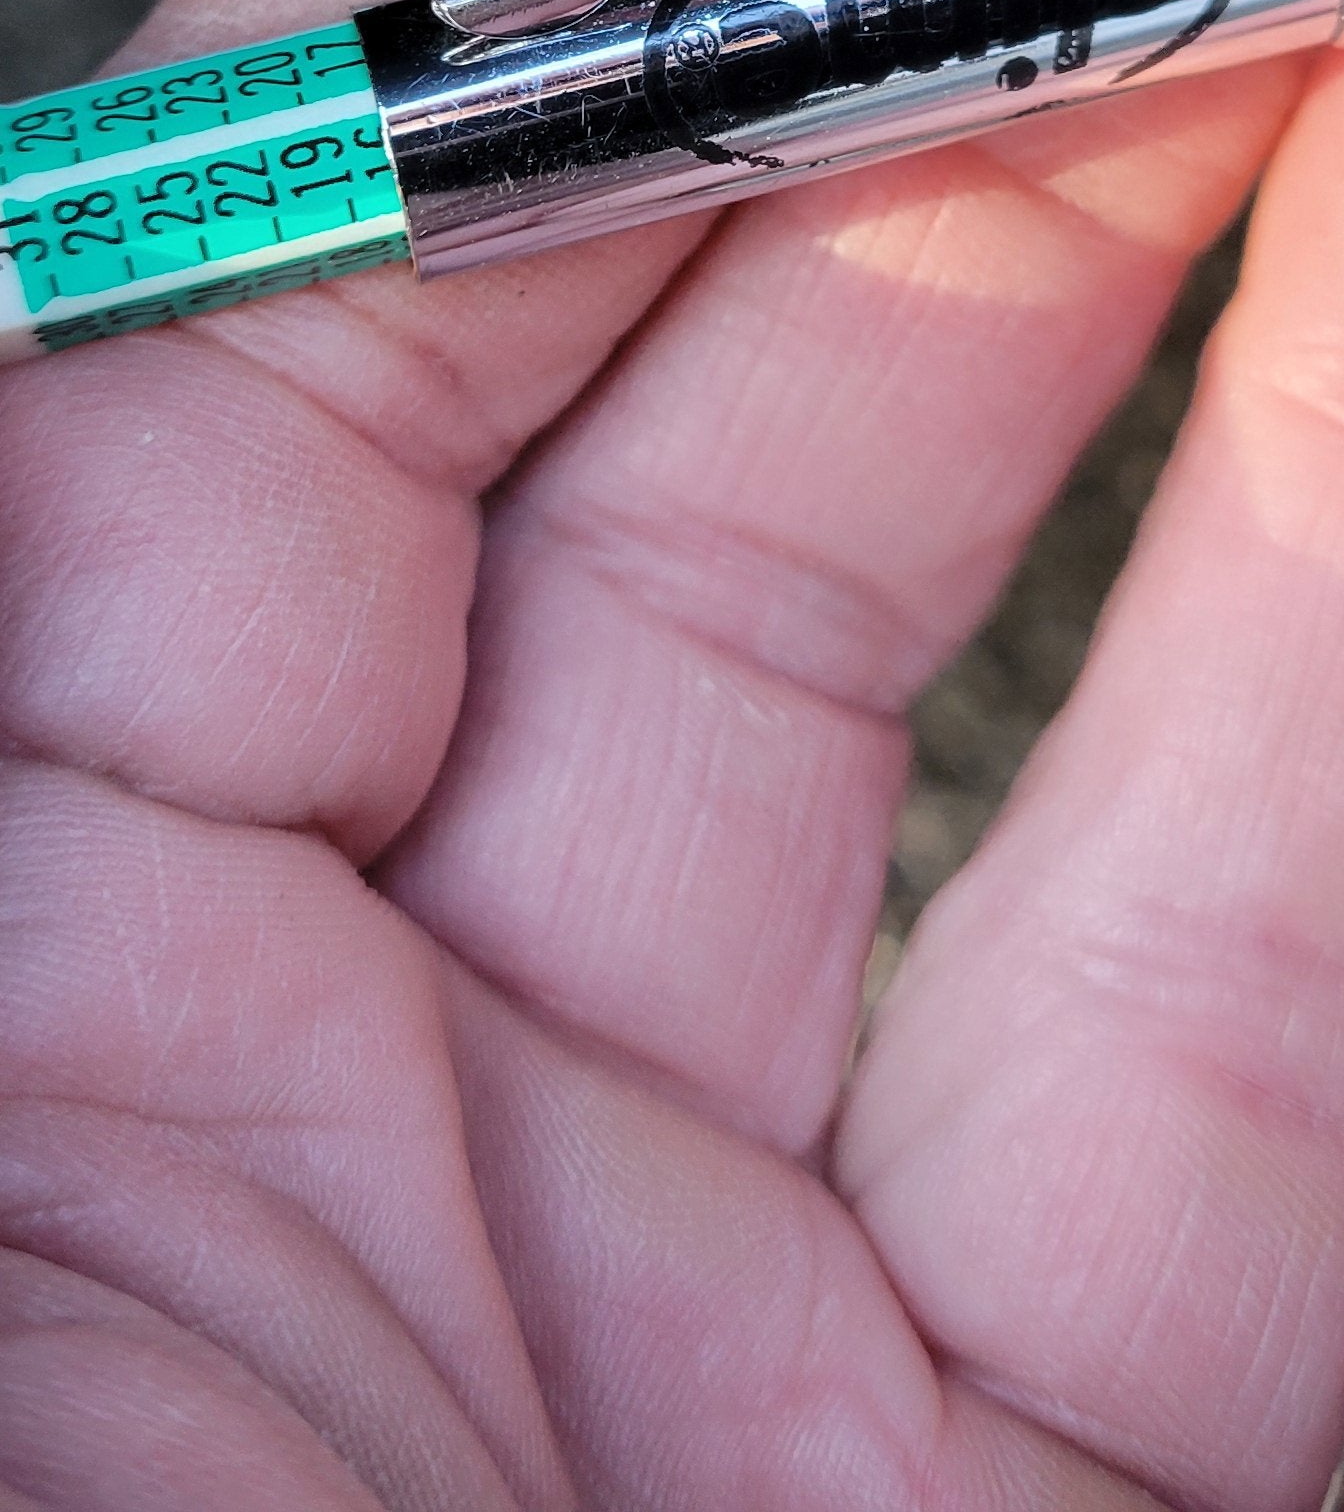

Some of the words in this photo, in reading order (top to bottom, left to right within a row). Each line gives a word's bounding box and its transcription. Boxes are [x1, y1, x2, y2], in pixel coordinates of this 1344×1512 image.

[234, 51, 304, 97] 20
[305, 40, 365, 77] 17
[91, 85, 159, 132] 26
[161, 69, 229, 114] 23
[11, 107, 78, 152] 29
[205, 149, 279, 217] 22
[279, 135, 354, 198] 19
[52, 189, 127, 256] 28
[134, 171, 206, 235] 25
